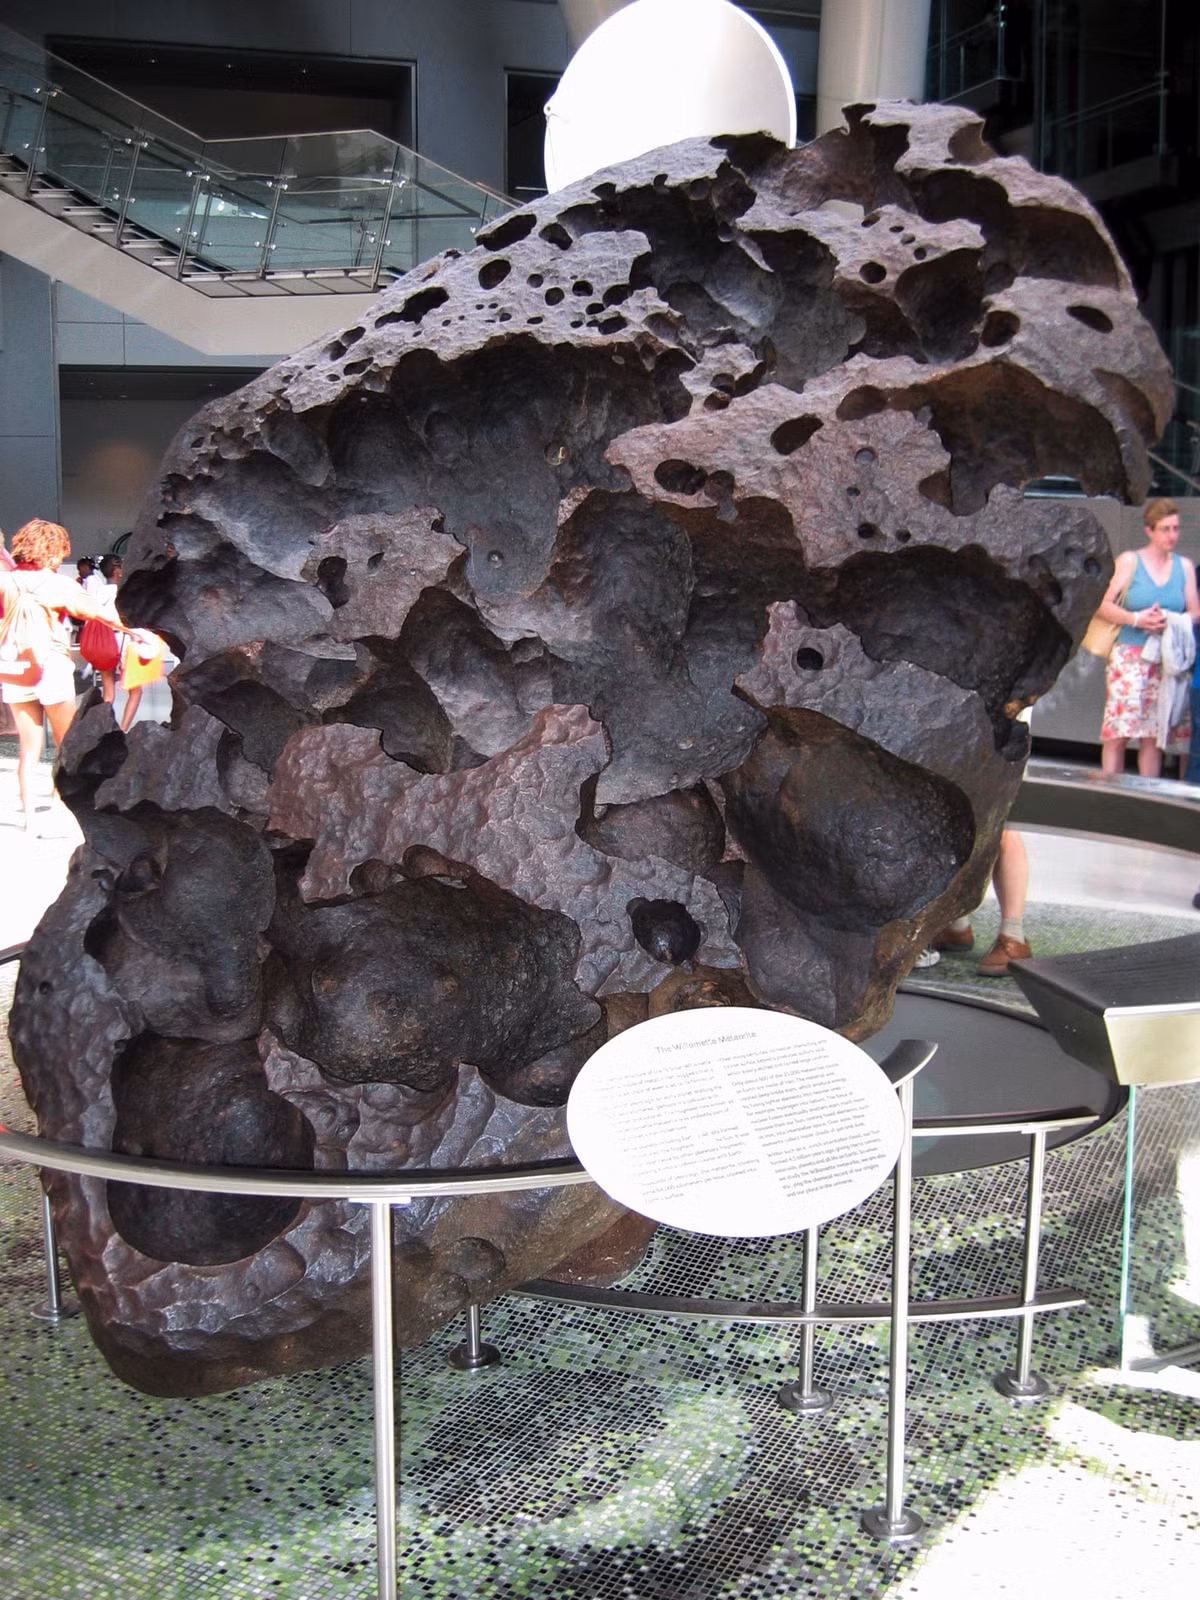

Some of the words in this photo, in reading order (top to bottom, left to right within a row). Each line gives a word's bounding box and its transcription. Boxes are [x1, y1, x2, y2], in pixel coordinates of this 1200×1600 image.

[655, 1045, 671, 1054] The
[672, 1038, 717, 1051] Willamette
[717, 1031, 756, 1043] Meteorite
